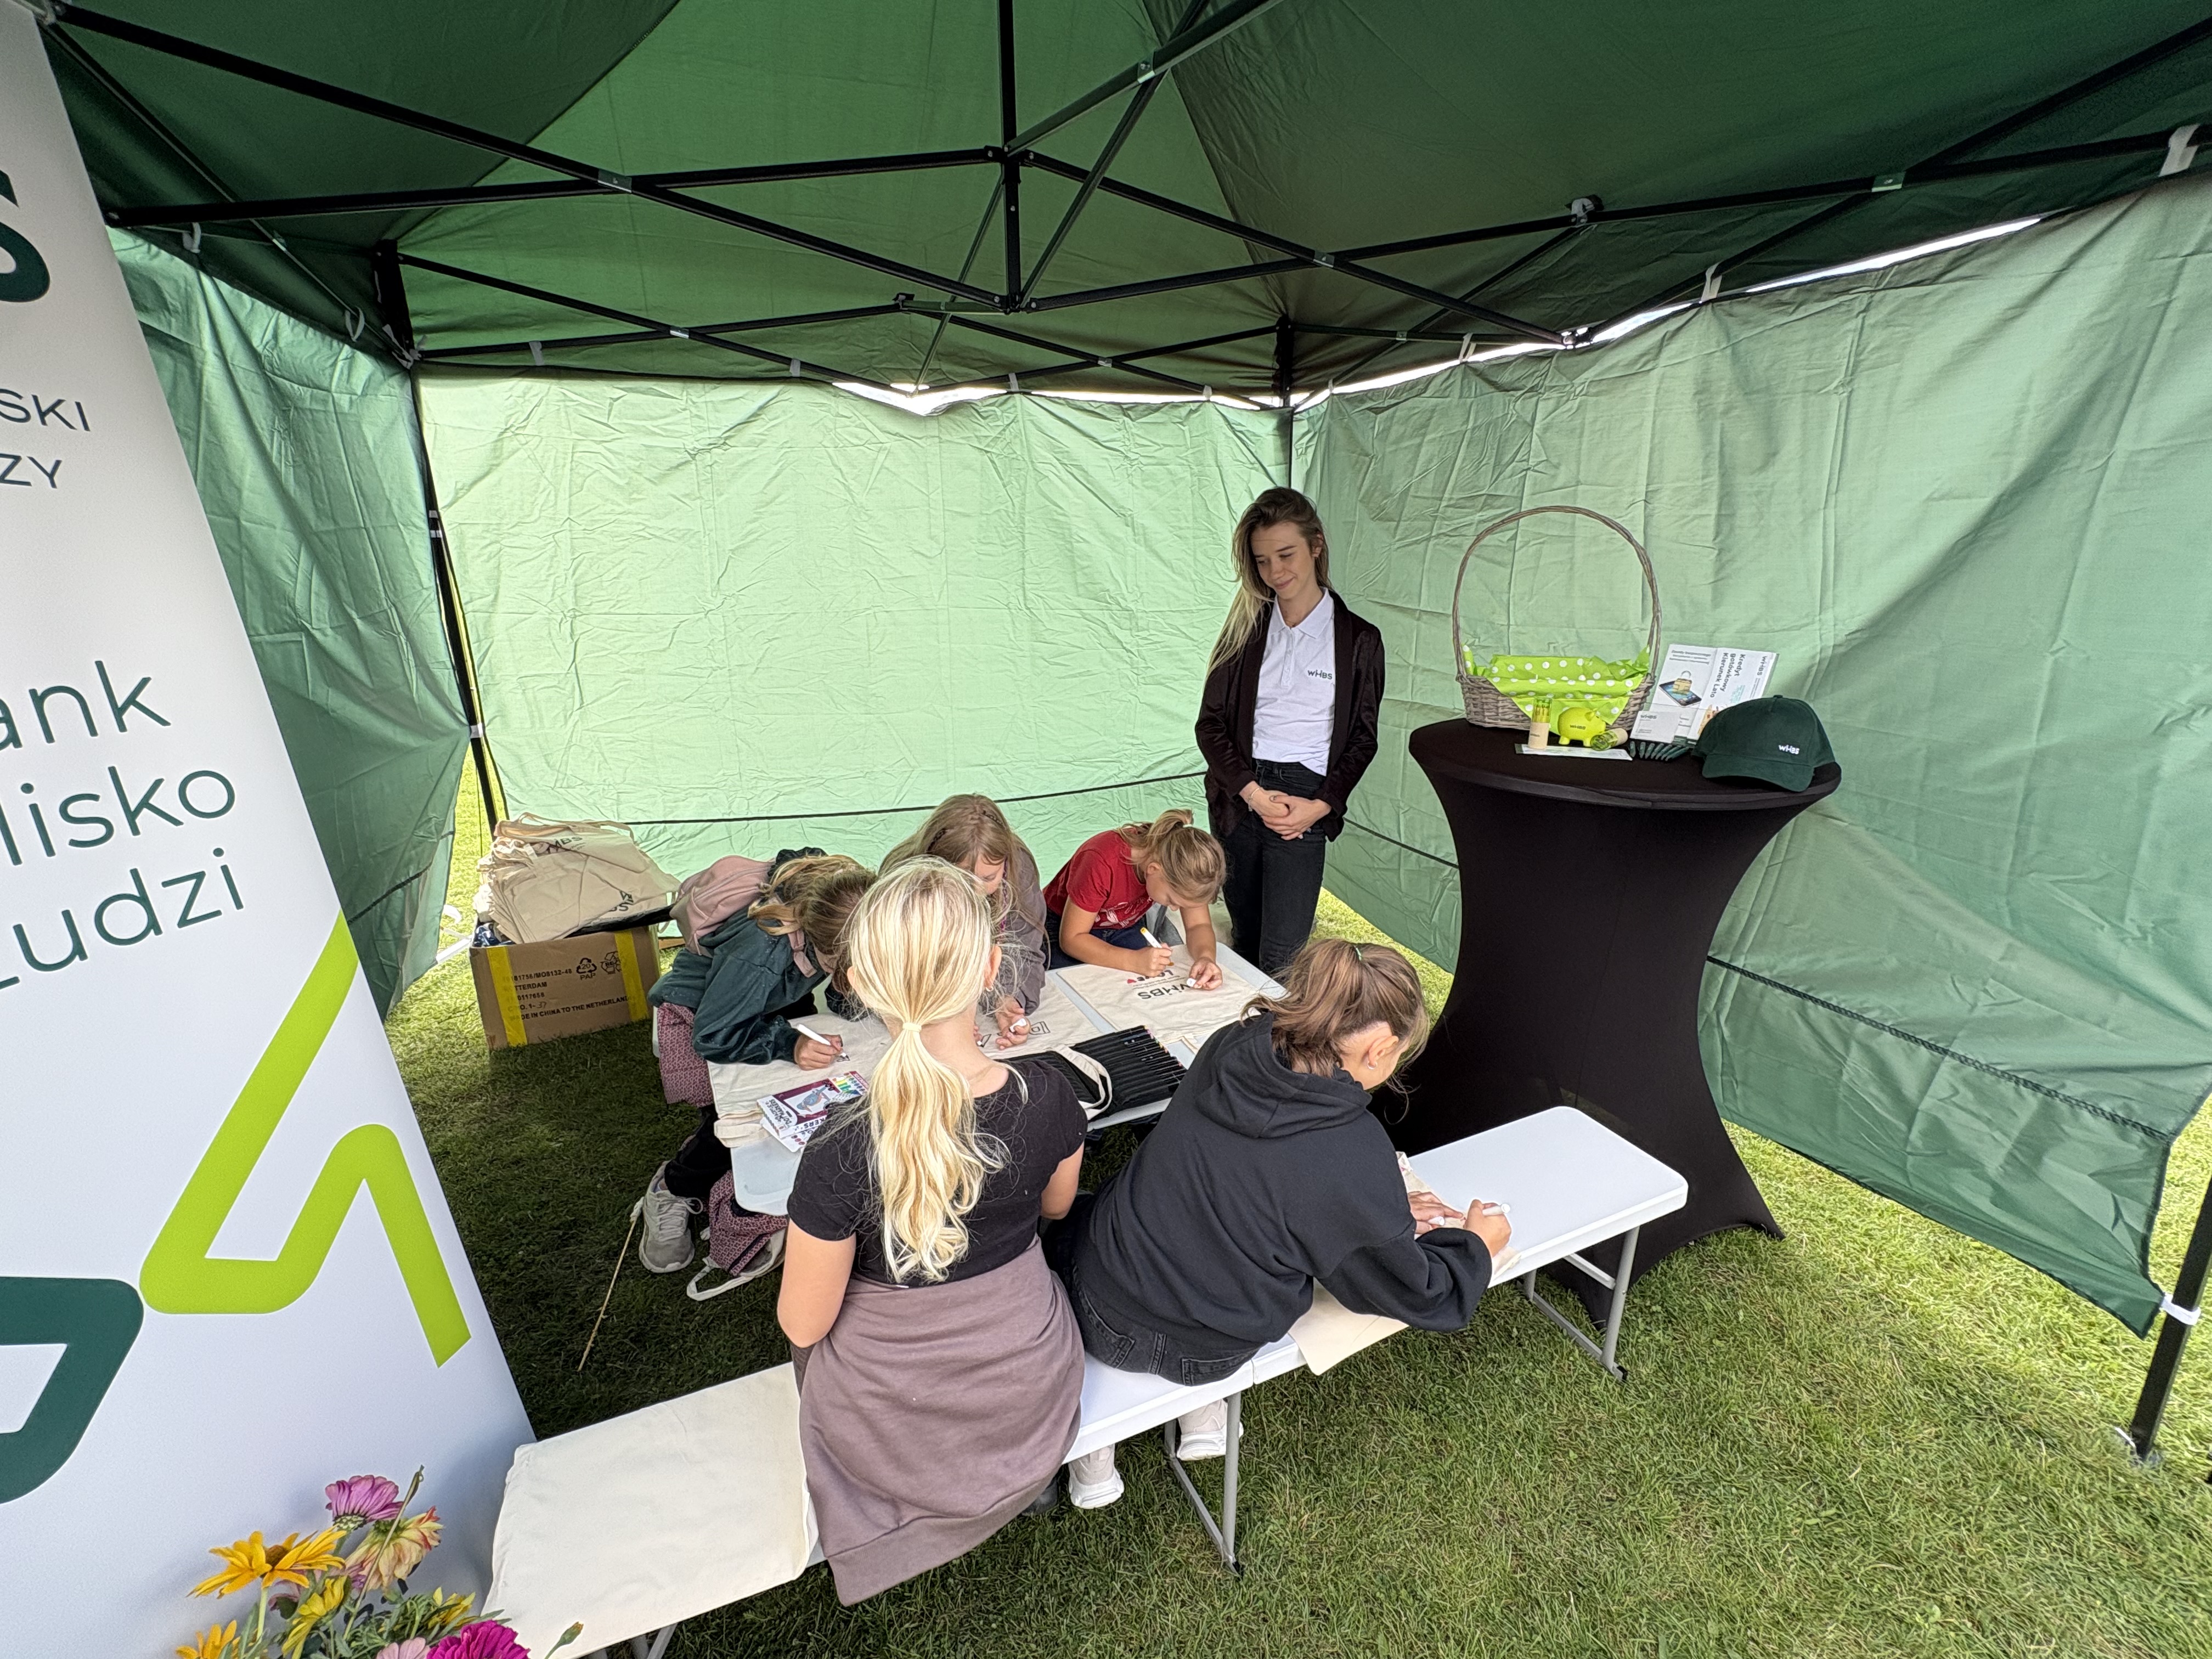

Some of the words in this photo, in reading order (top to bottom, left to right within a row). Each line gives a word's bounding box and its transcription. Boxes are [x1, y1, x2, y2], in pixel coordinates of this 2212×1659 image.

[1716, 653, 1729, 682] Kierunek
[1734, 654, 1746, 676] Kredyt
[1710, 684, 1720, 698] Lato
[0, 848, 244, 988] udzi
[514, 982, 548, 991] TTERDAM
